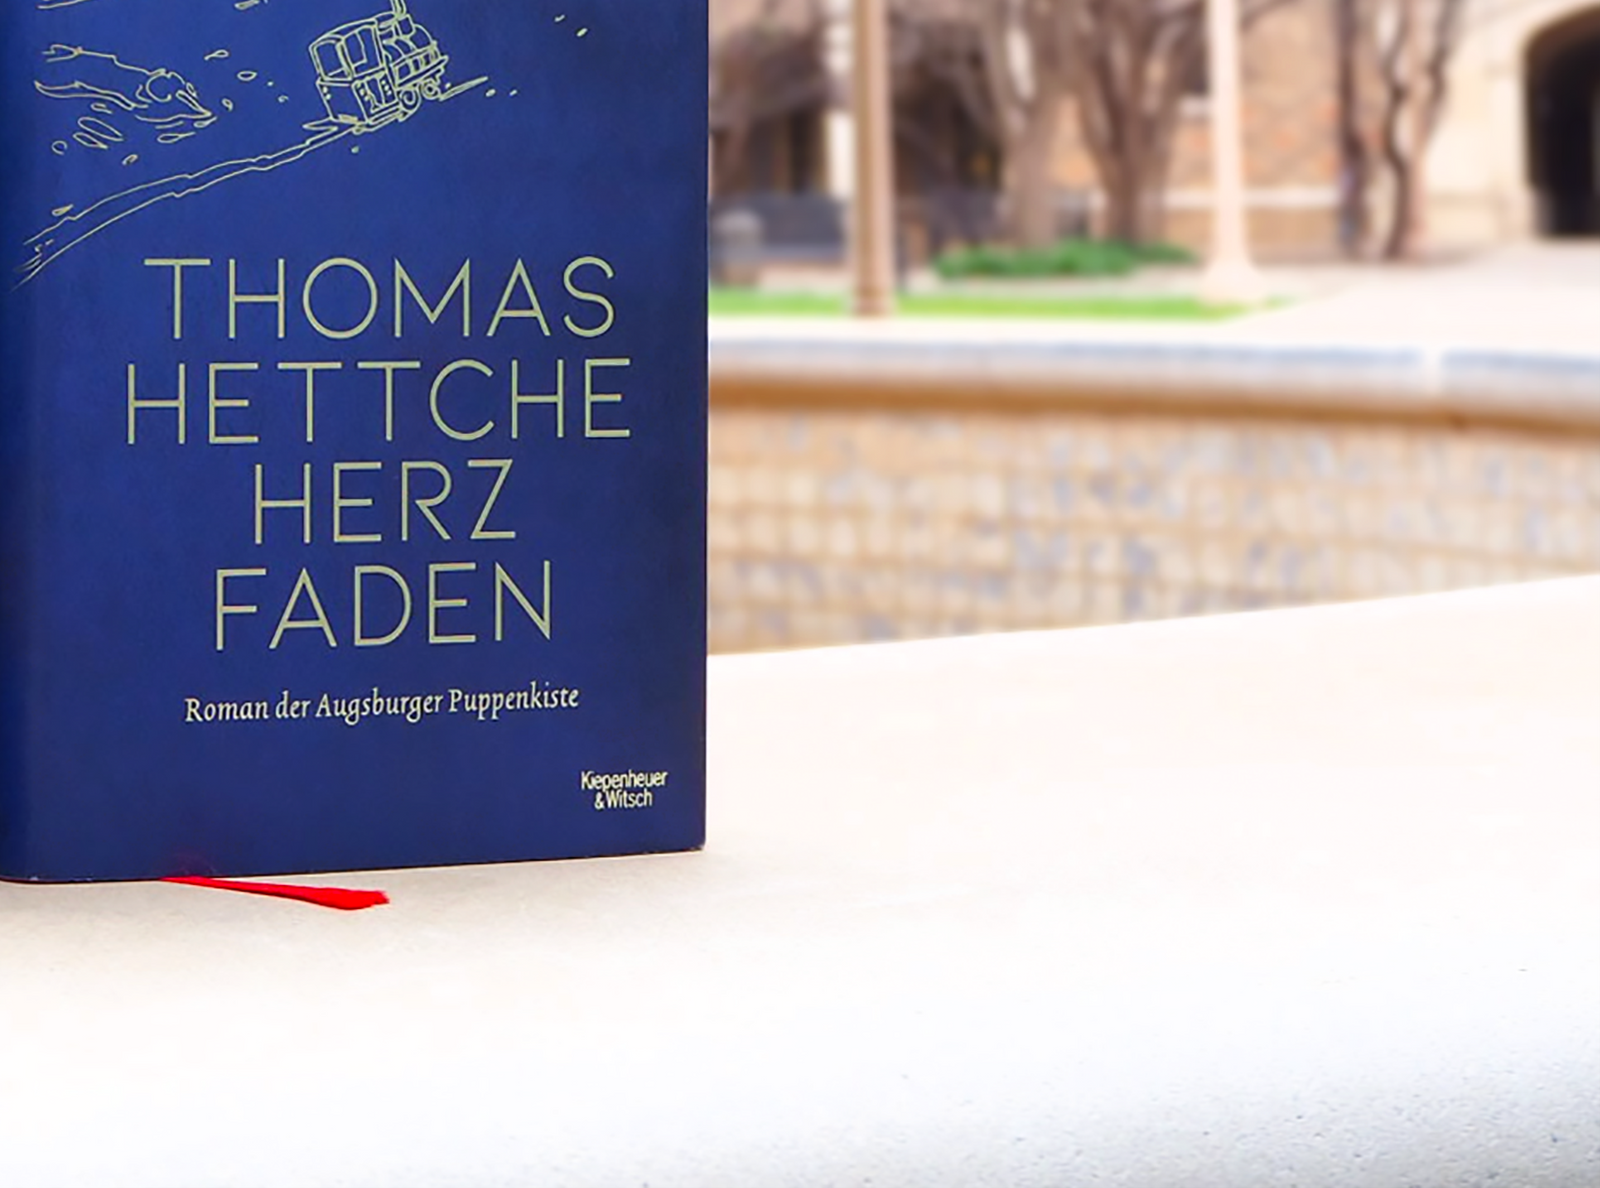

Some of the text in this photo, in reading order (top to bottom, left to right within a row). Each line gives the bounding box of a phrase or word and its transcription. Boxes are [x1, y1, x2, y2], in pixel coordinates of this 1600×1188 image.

[143, 256, 615, 340] THOMAS
[127, 358, 631, 445] HETTCHE
[254, 458, 517, 545] HERZ
[216, 560, 551, 651] FADEN
[184, 680, 580, 726] Roman der Augsburger Puppenkiste
[580, 769, 669, 792] Kiepenheuer
